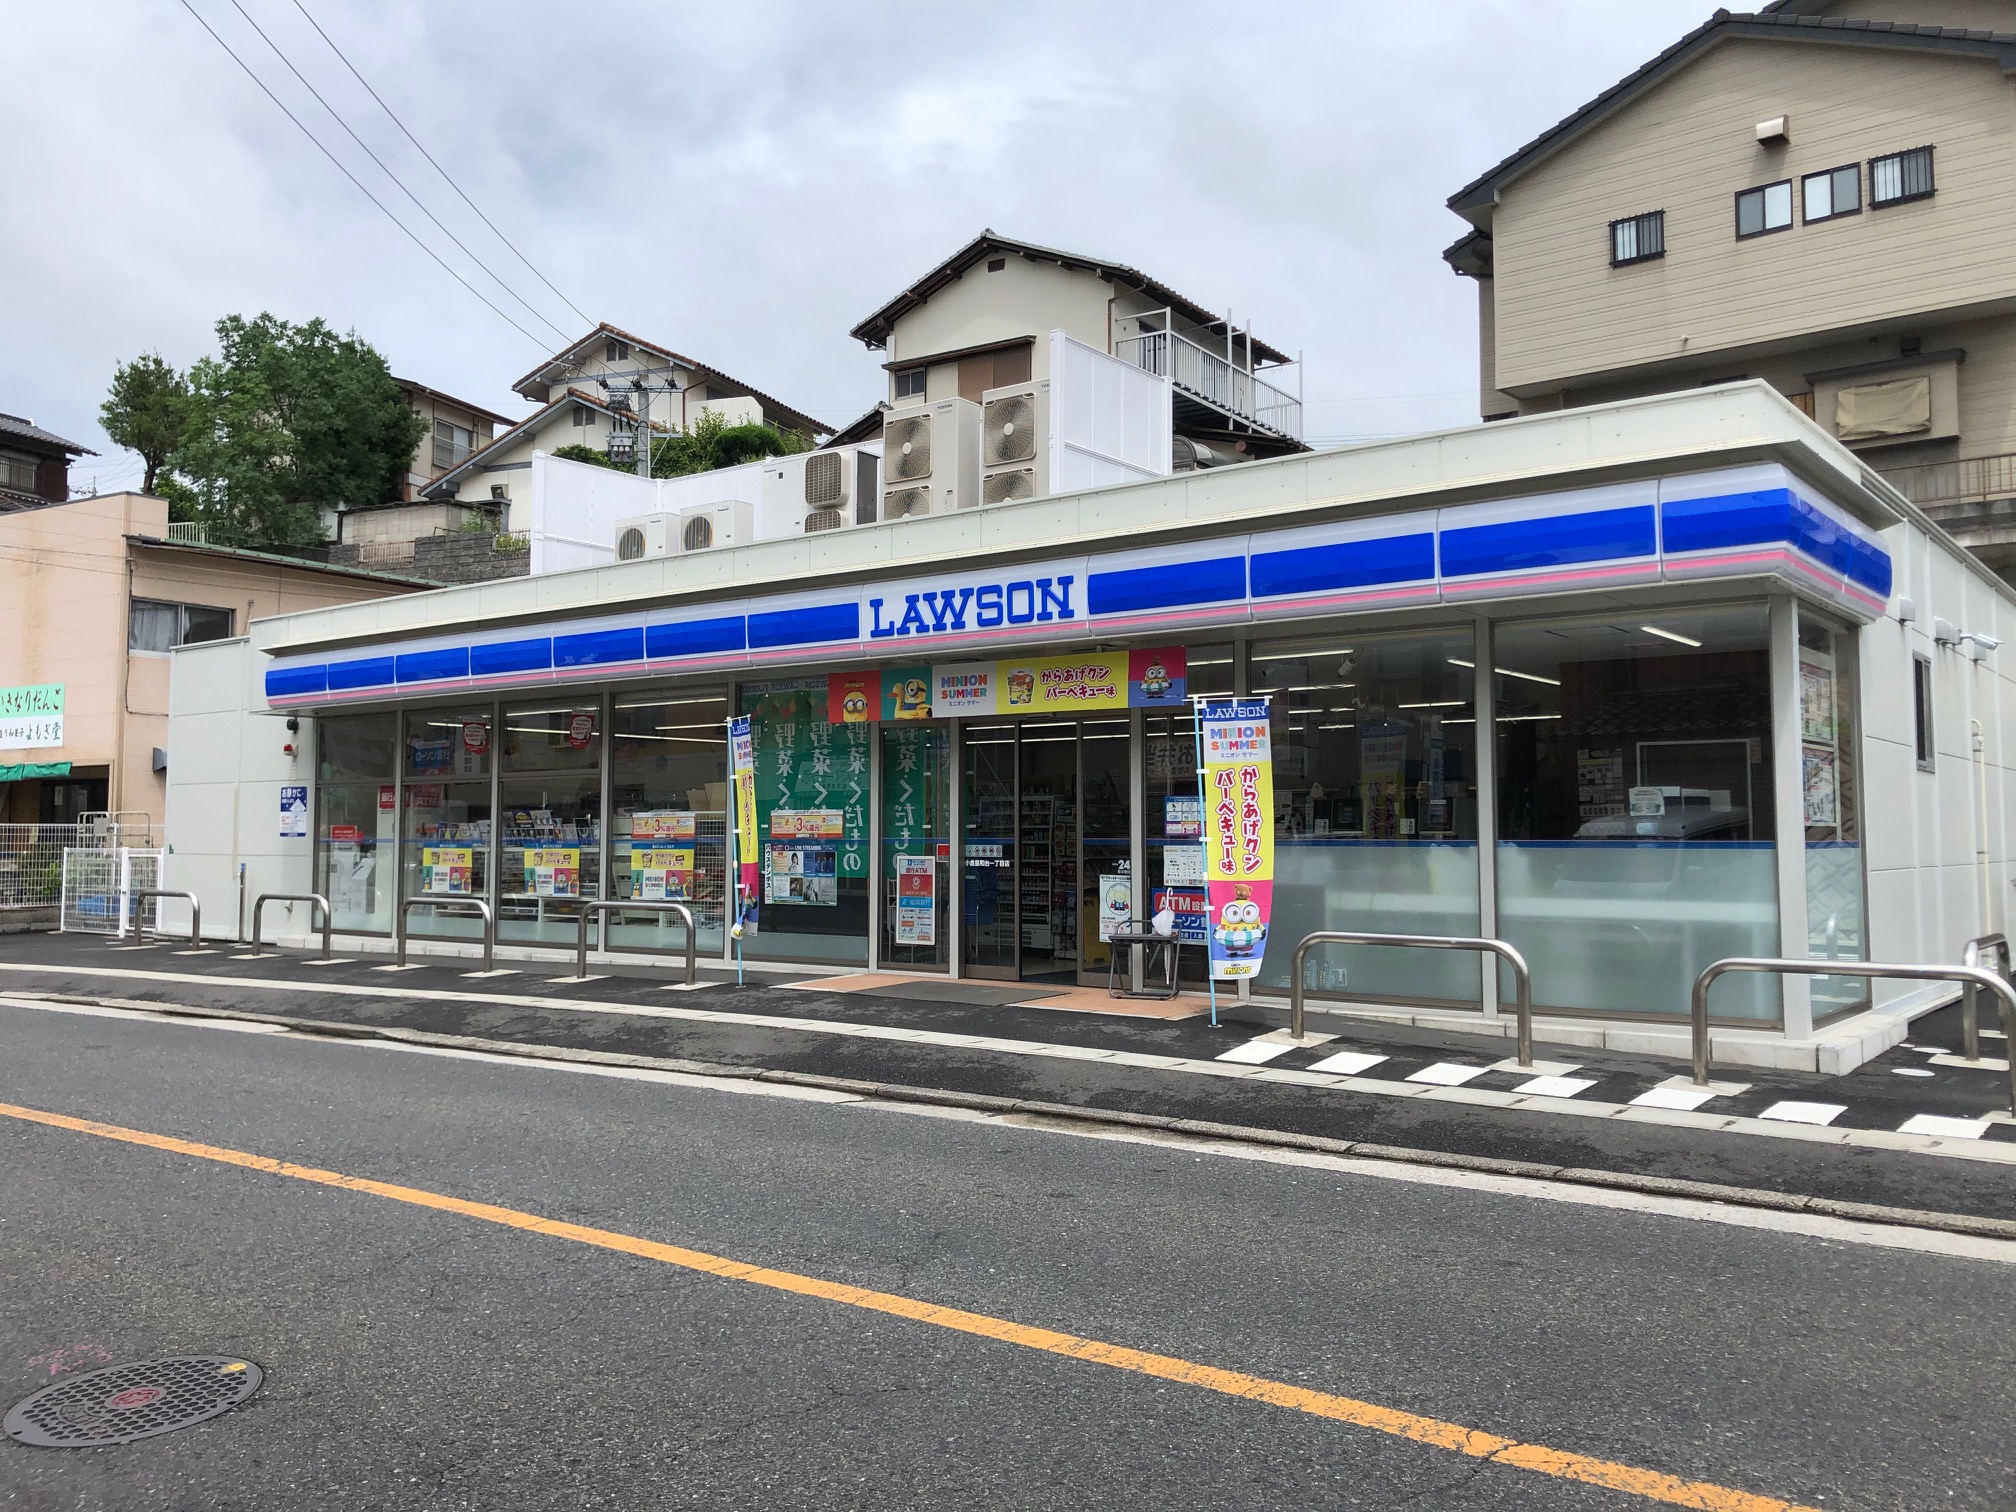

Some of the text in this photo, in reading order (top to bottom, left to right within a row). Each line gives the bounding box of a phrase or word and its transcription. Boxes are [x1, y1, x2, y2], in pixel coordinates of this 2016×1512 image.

[870, 575, 1075, 638] LAWSON
[941, 673, 988, 688] MINION
[1040, 665, 1111, 683] からあげクン
[941, 688, 987, 700] SUMMER
[1045, 682, 1118, 700] バーベキュー味
[1206, 706, 1266, 718] LAWSON
[1210, 726, 1266, 739] MINION
[1211, 740, 1266, 751] SUMMER
[1215, 768, 1237, 874] バーベキュー味
[1240, 765, 1263, 874] からあげクン
[1117, 859, 1131, 870] 24
